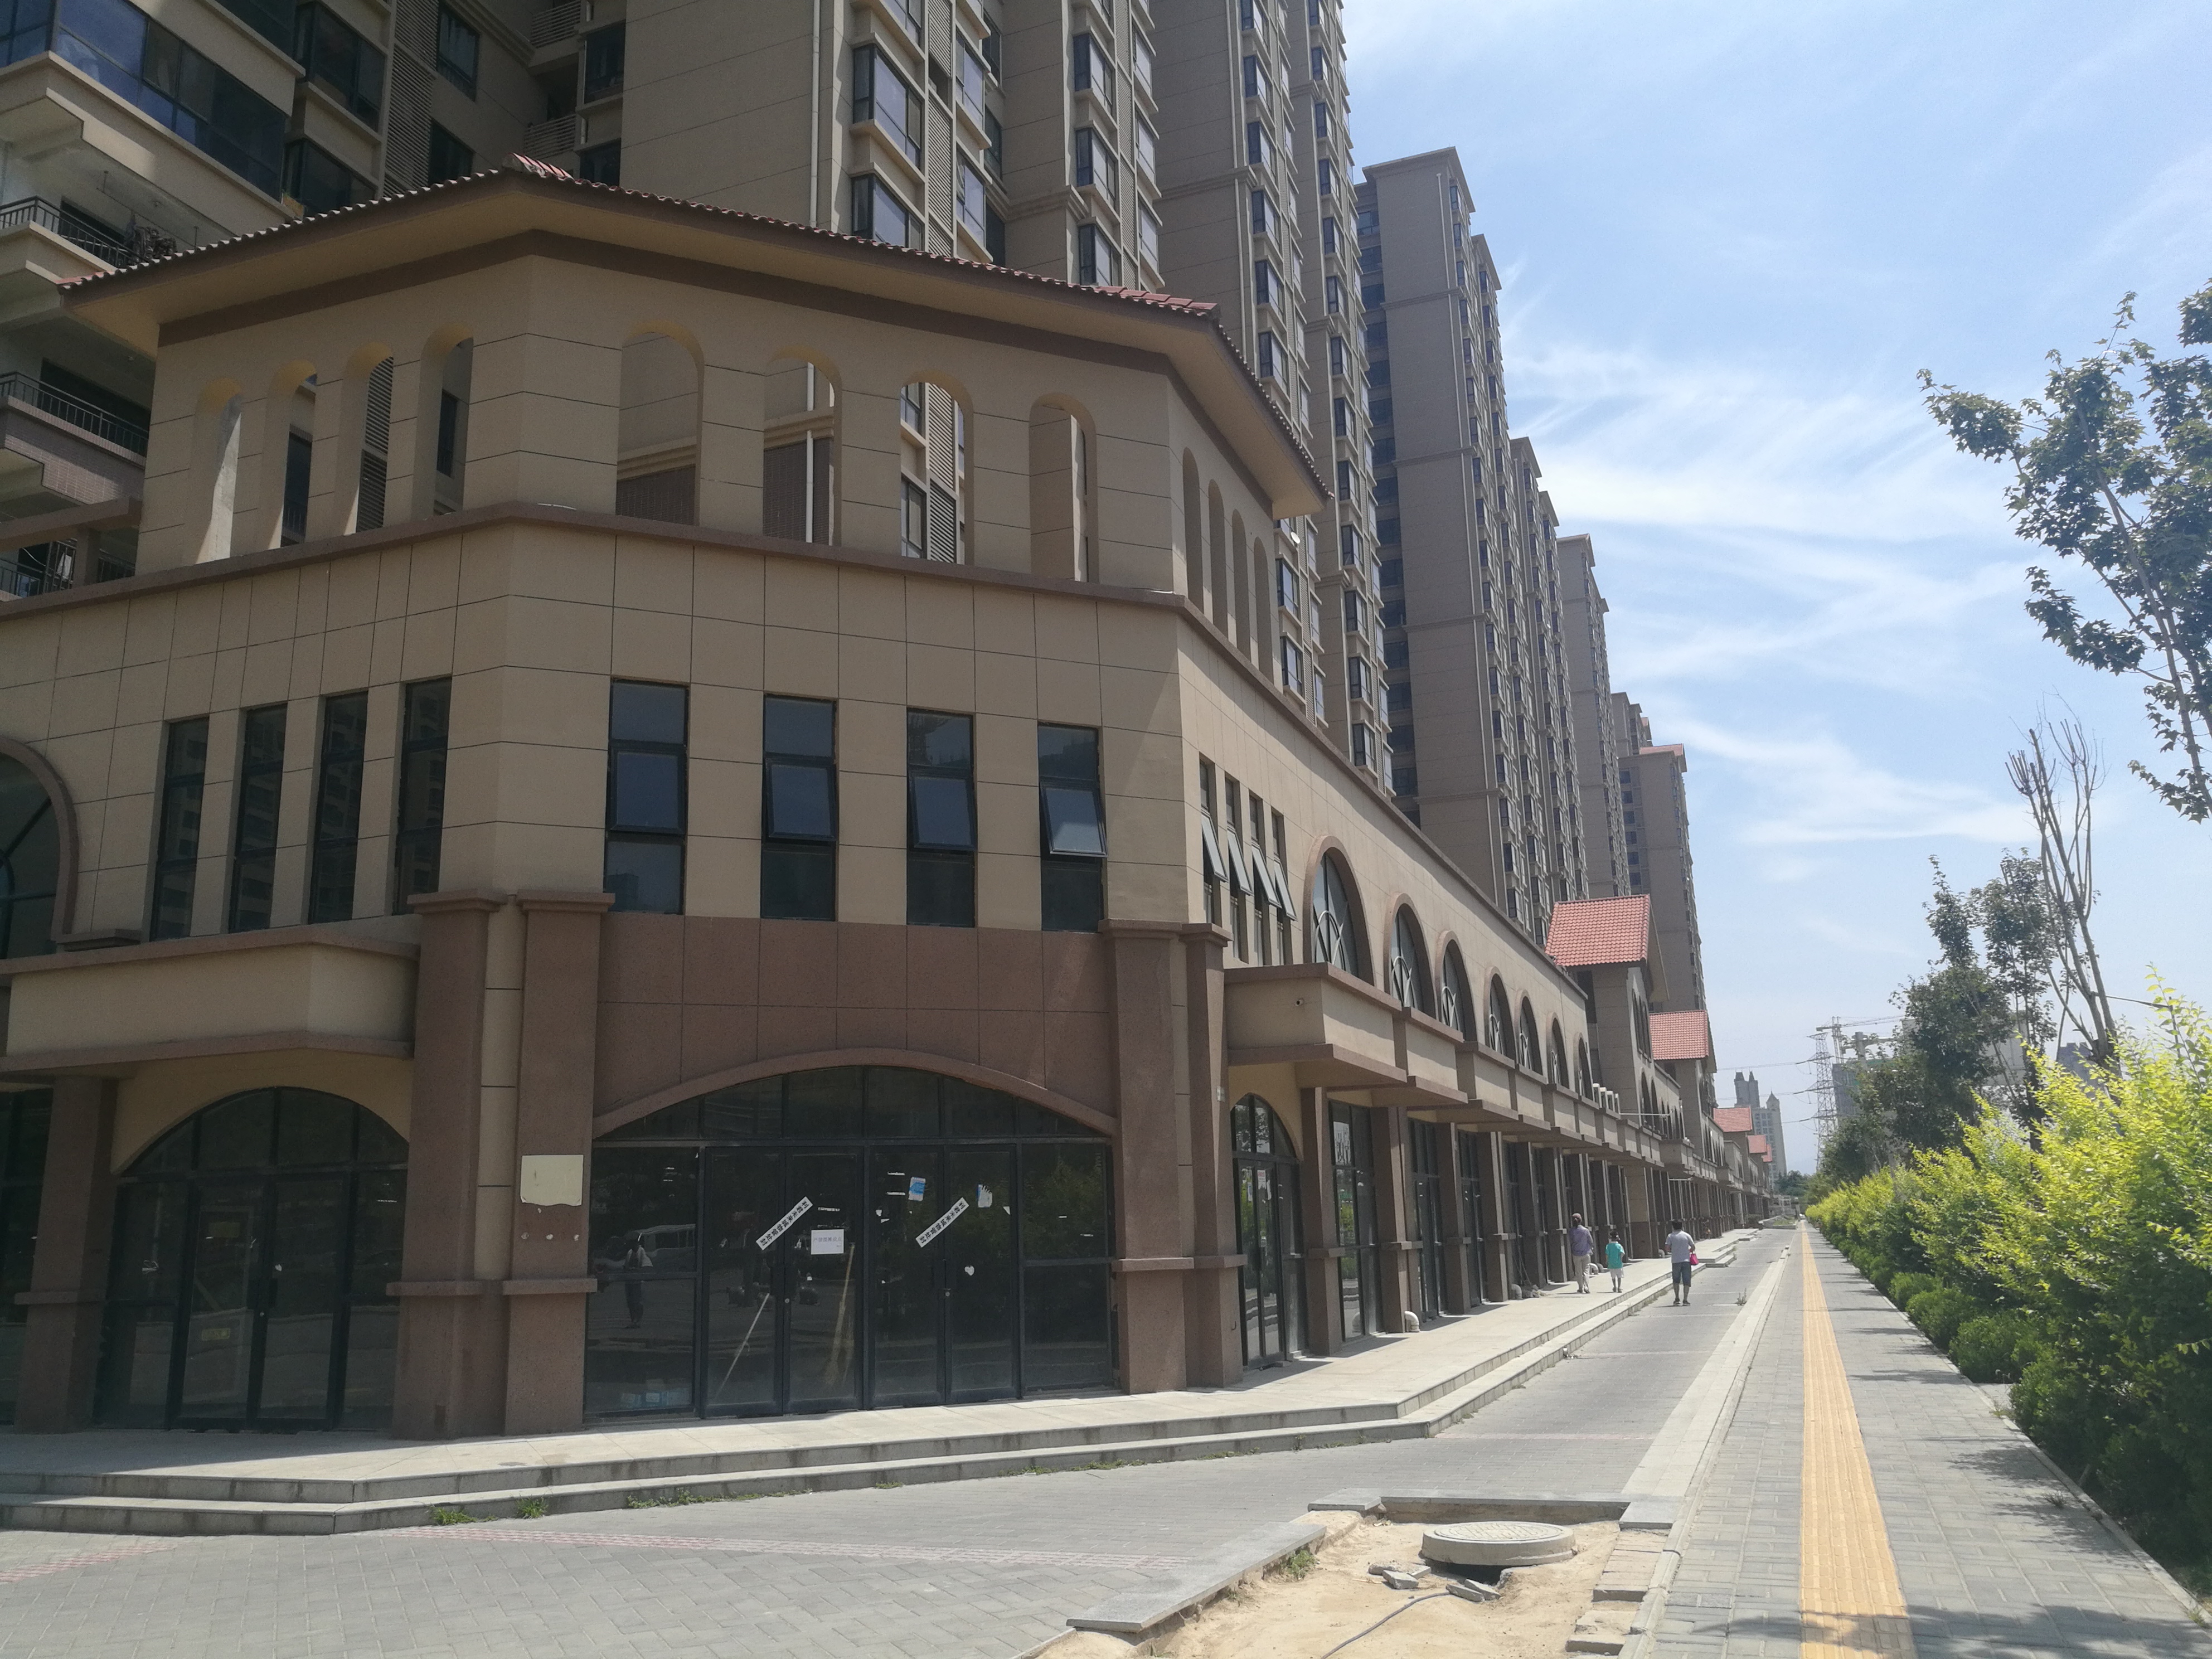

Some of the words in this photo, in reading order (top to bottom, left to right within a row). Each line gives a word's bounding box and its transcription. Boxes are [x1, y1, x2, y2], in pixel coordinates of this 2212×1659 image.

[759, 1200, 809, 1246] 利君未来城物管处封
[919, 1201, 966, 1244] 利君未来城物管处封
